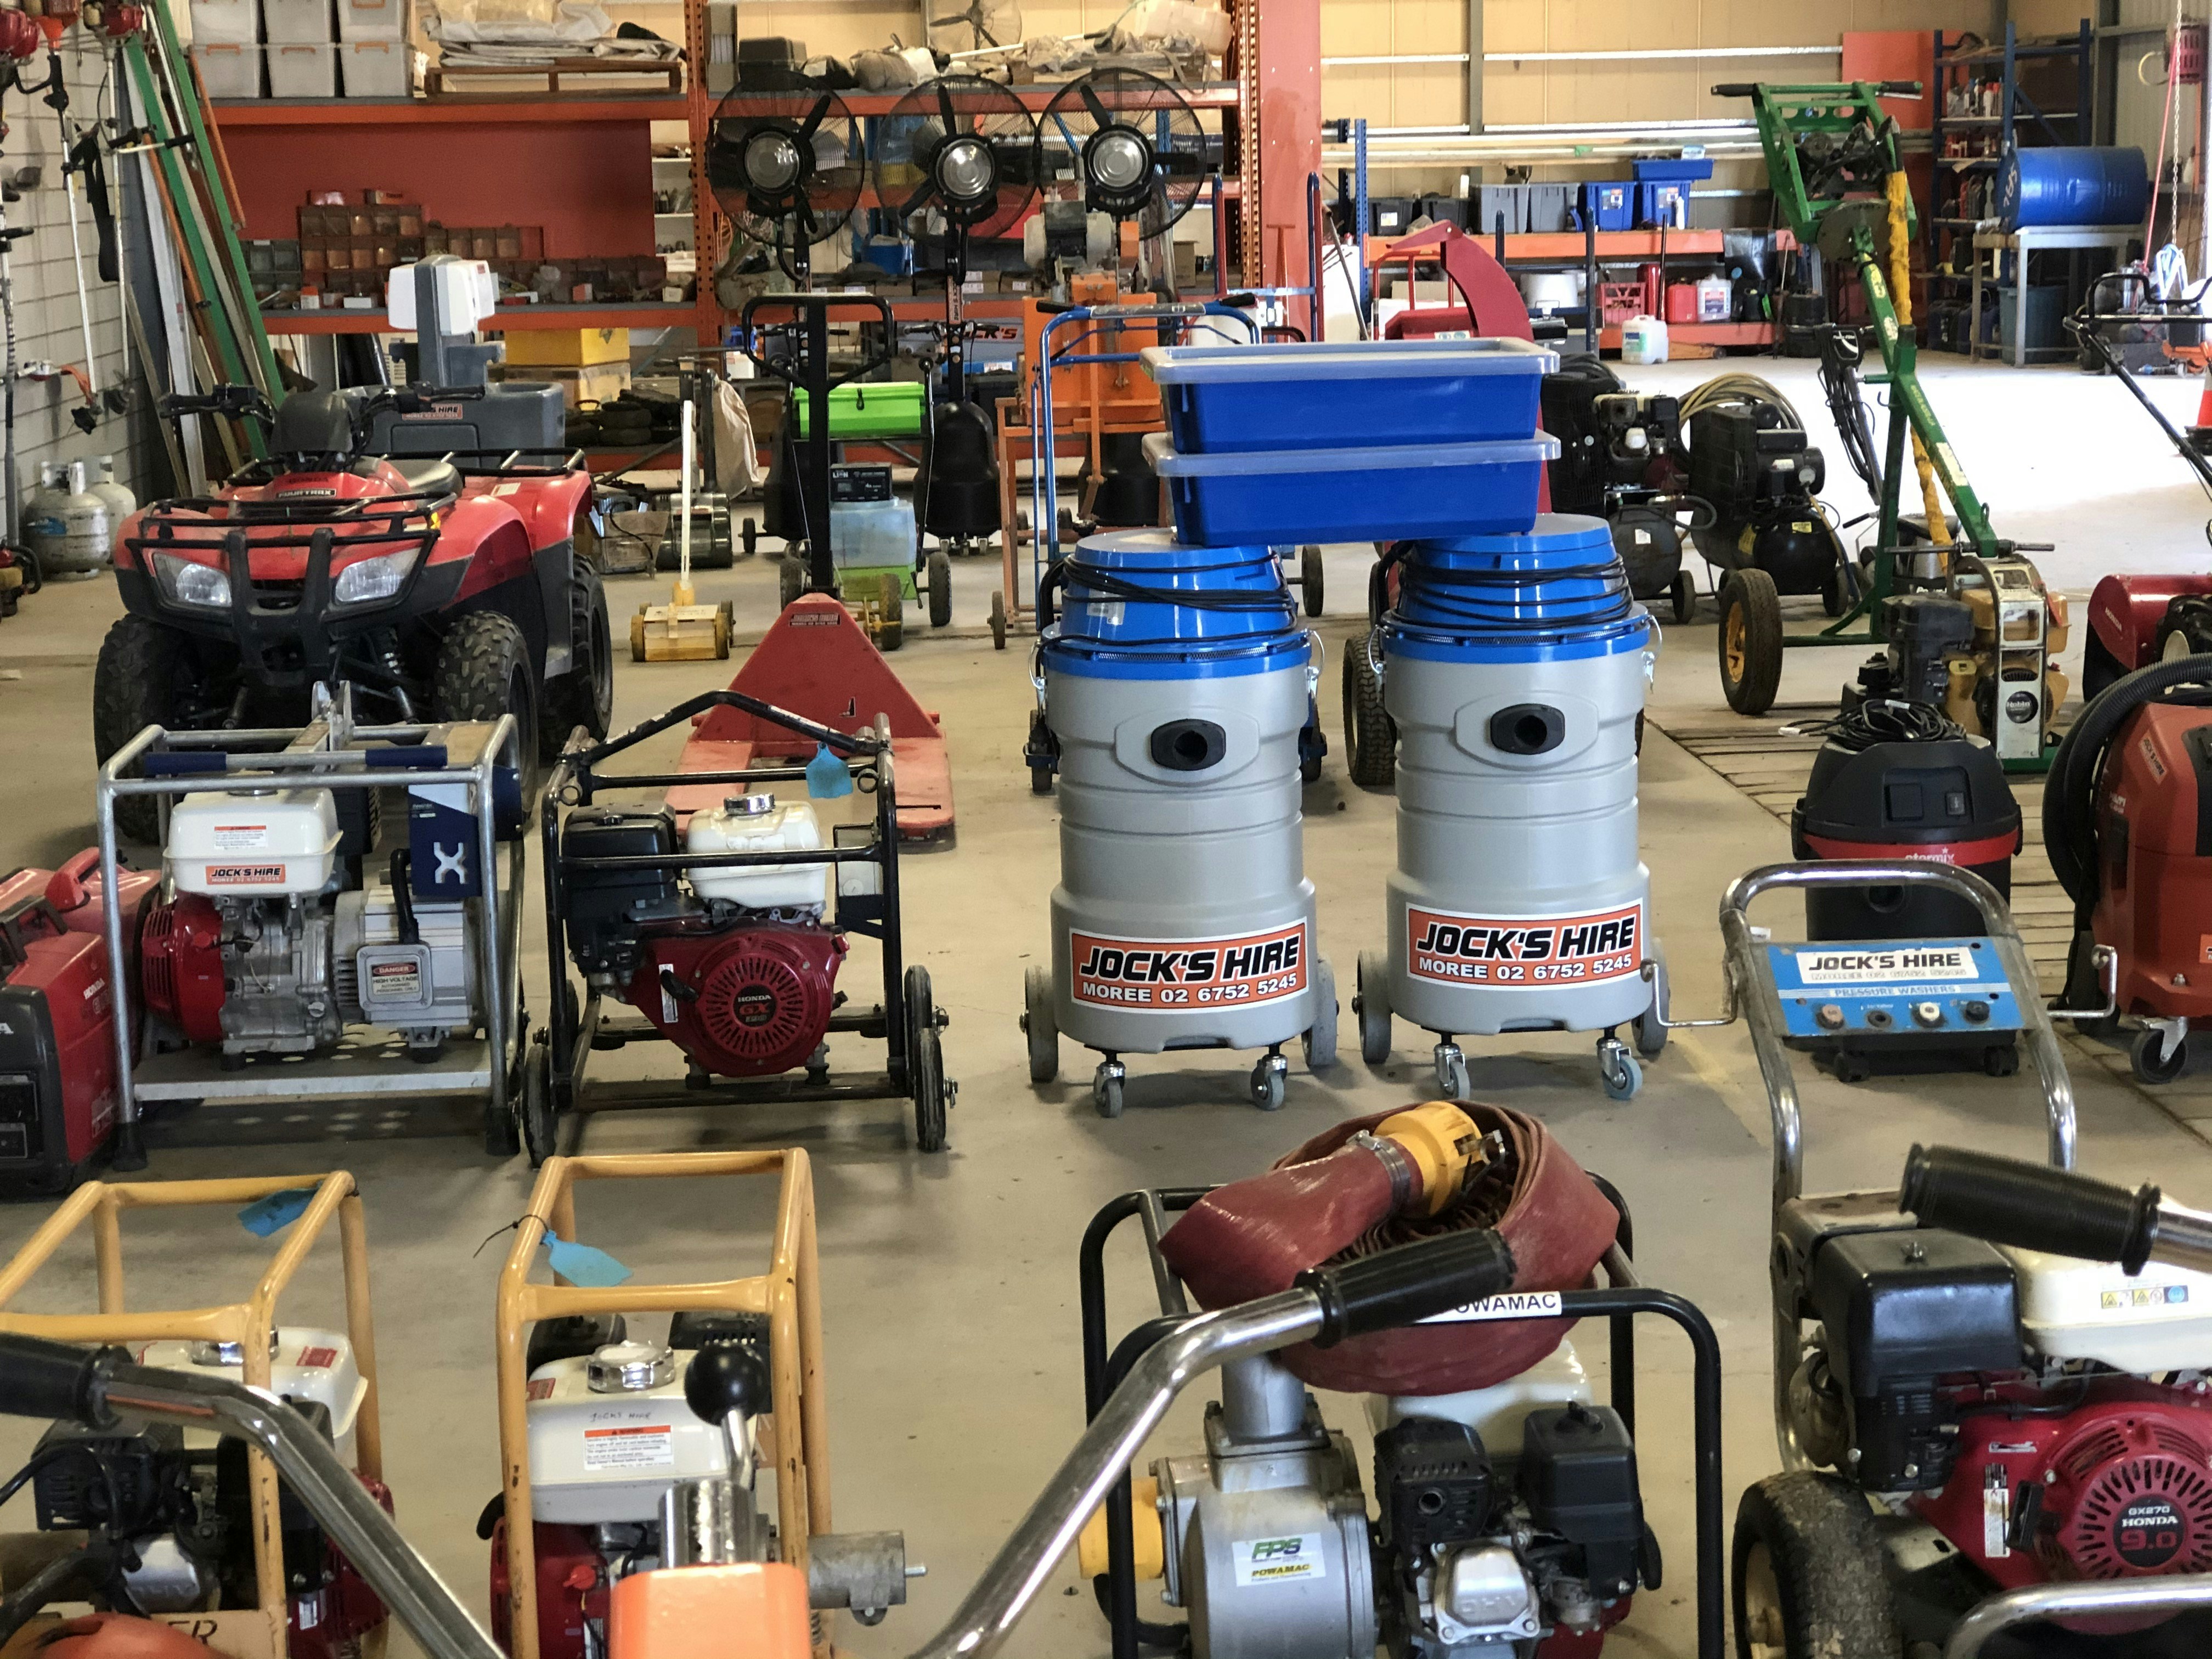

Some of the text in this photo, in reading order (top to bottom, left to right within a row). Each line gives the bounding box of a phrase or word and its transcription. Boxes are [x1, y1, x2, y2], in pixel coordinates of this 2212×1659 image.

[211, 867, 281, 877] JOCK'S HIRE
[1417, 916, 1636, 960] JOCK'S HIRE
[1080, 935, 1300, 983] JOCK'S HIRE
[1419, 953, 1632, 980] MOREE 02 6752 5245
[1809, 952, 1962, 970] JOCK'S HIRE
[83, 978, 105, 1000] HONDA
[1083, 972, 1297, 1003] MOREE 02 6752 5245
[1835, 986, 1956, 996] PRESSURE WASHERS
[739, 1003, 769, 1015] GX
[1455, 1294, 1557, 1313] OWAMAC
[2128, 1505, 2171, 1516] GX270
[2121, 1515, 2179, 1528] HONDA
[2121, 1529, 2177, 1551] 9.0
[1252, 1564, 1311, 1577] POWAMAC
